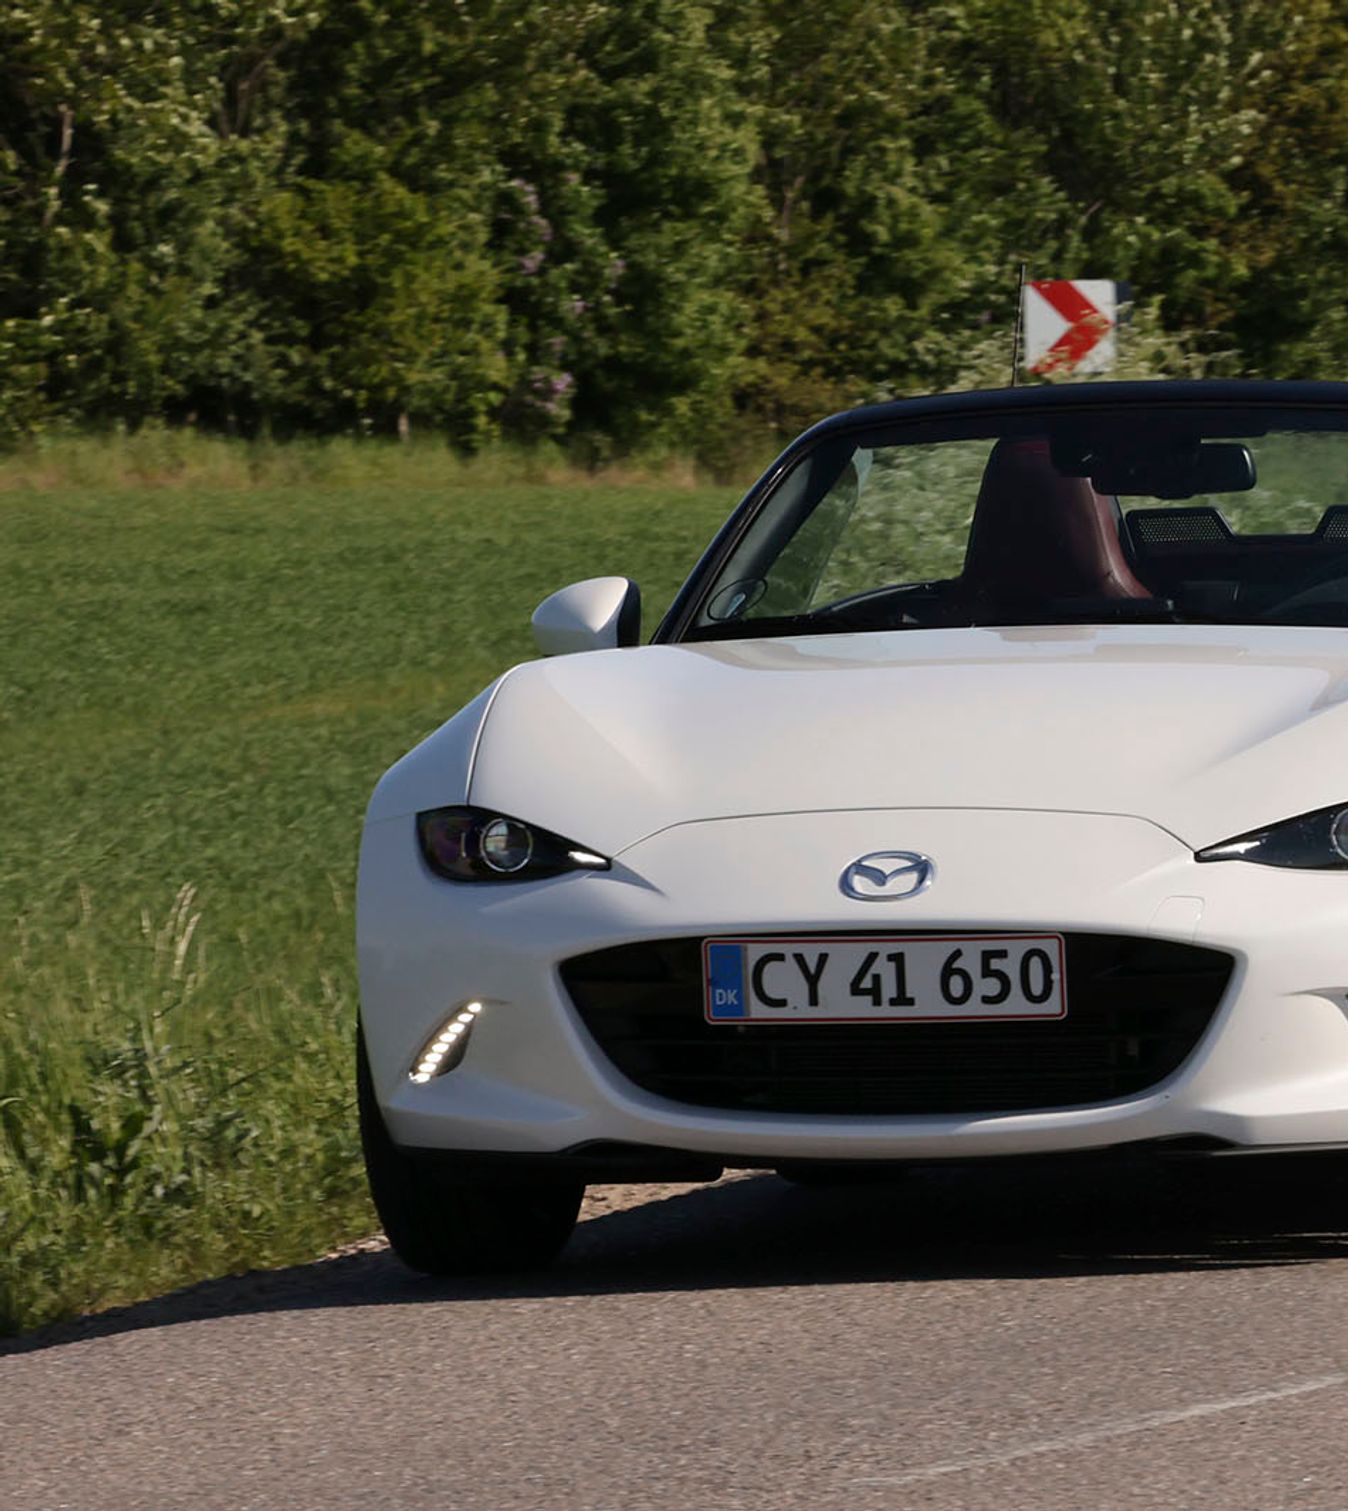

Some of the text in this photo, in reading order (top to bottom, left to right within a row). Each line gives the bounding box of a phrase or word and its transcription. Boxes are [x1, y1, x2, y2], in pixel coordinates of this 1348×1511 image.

[752, 948, 1054, 1008] CY 41 650
[715, 989, 739, 1006] DK
